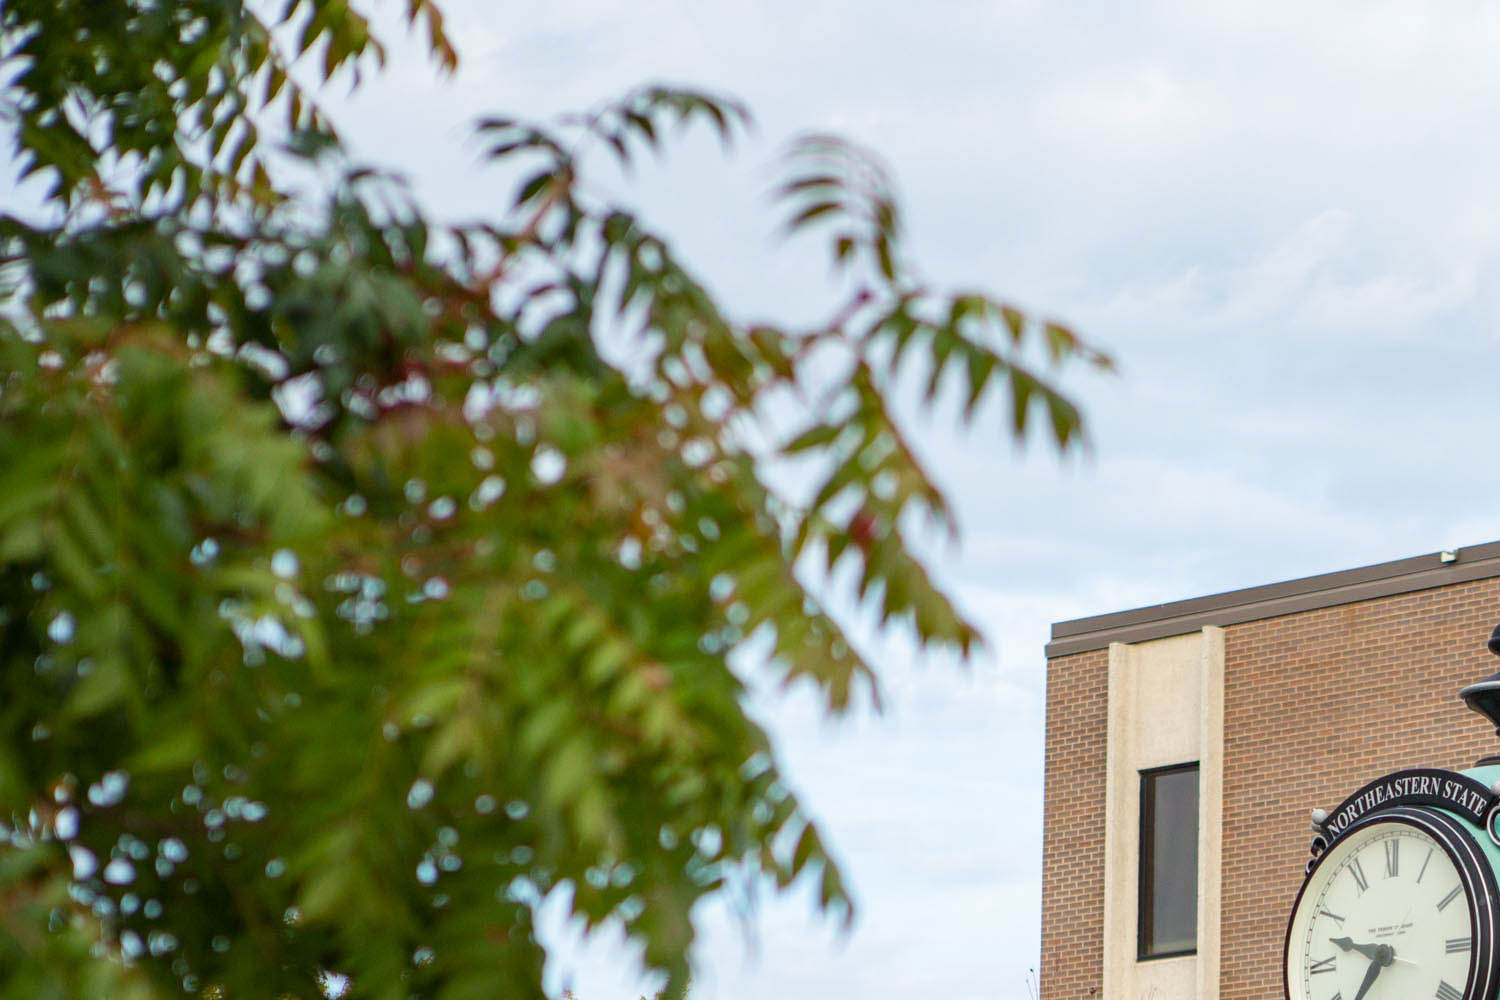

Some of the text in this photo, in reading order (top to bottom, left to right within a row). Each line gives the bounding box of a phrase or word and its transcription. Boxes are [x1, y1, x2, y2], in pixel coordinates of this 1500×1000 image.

[1327, 776, 1488, 840] NORTHEASTERN STATE
[1384, 839, 1399, 878] XII
[1437, 883, 1463, 912] II
[1446, 937, 1471, 953] III
